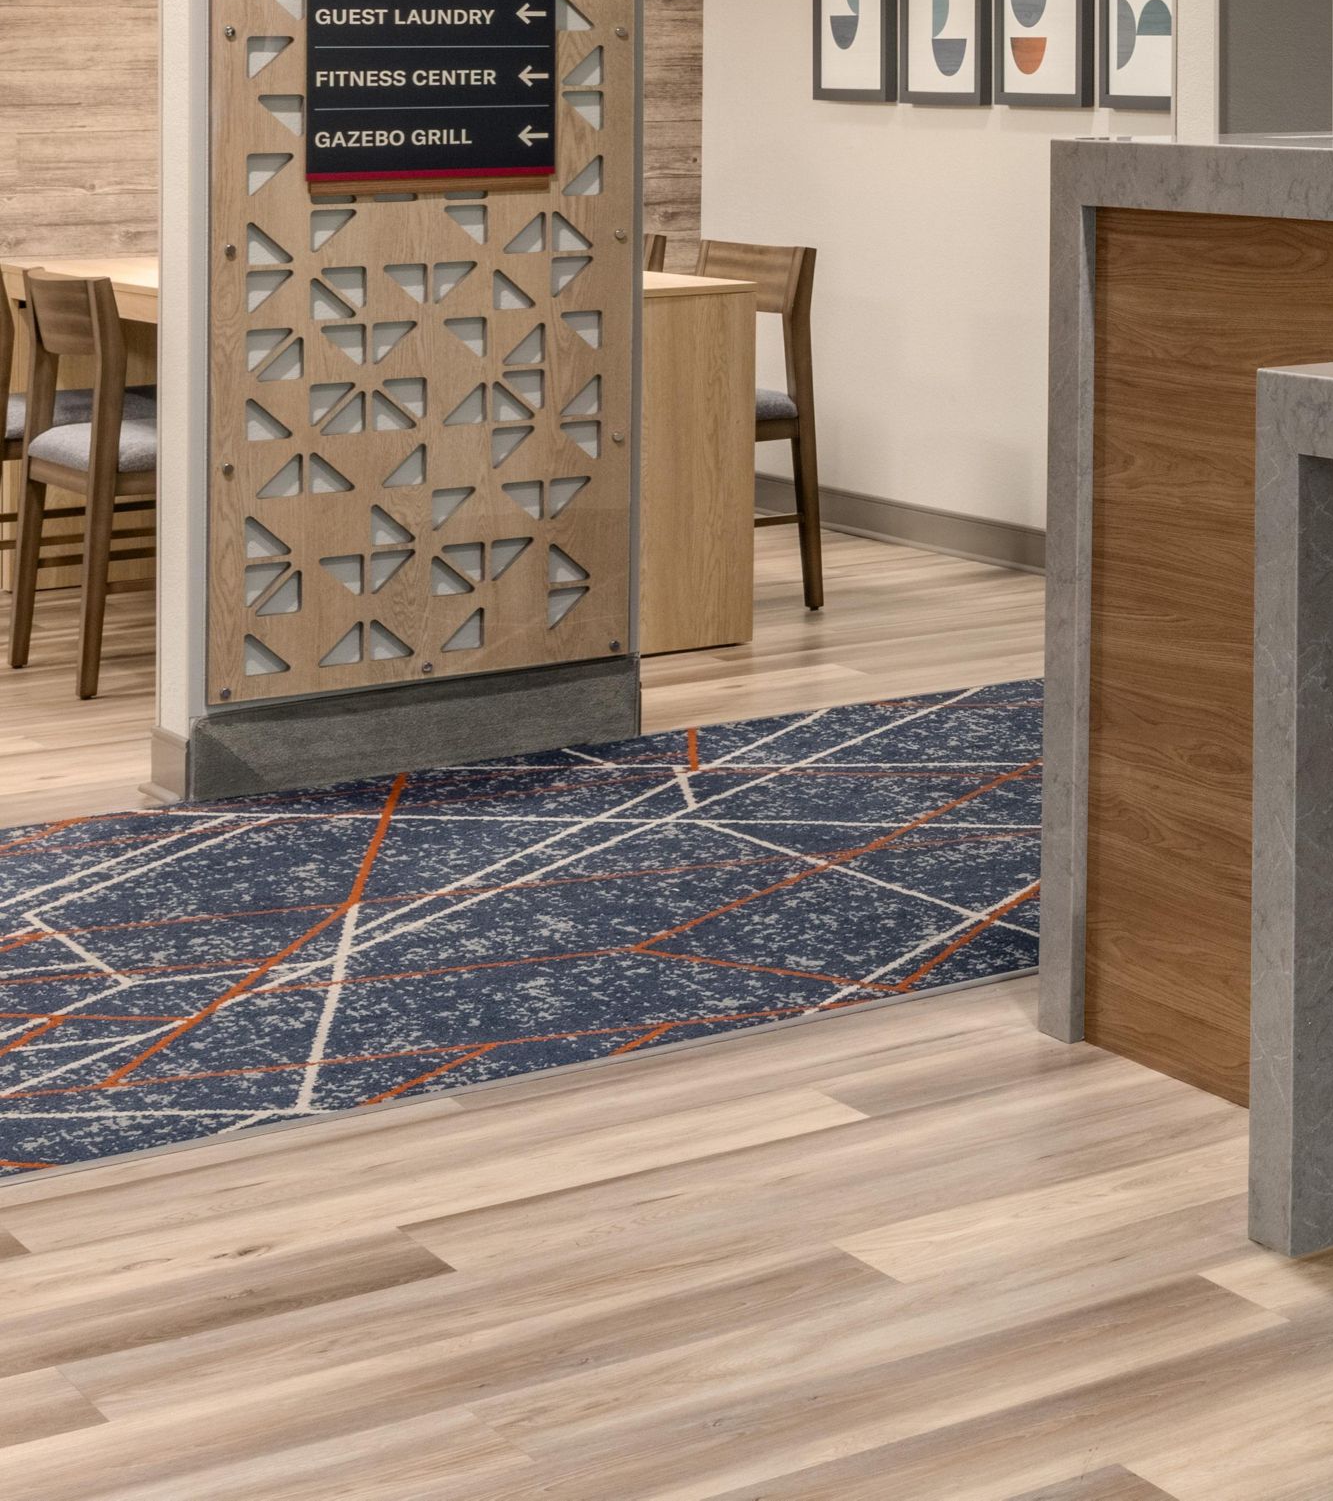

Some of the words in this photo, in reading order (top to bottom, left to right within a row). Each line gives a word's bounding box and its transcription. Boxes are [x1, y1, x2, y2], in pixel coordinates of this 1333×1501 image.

[315, 8, 388, 26] GUEST
[394, 8, 495, 26] LAUNDRY
[315, 70, 407, 88] FITNESS
[412, 69, 497, 86] CENTER
[314, 129, 405, 148] GAZEBO
[411, 128, 473, 147] GRILL
